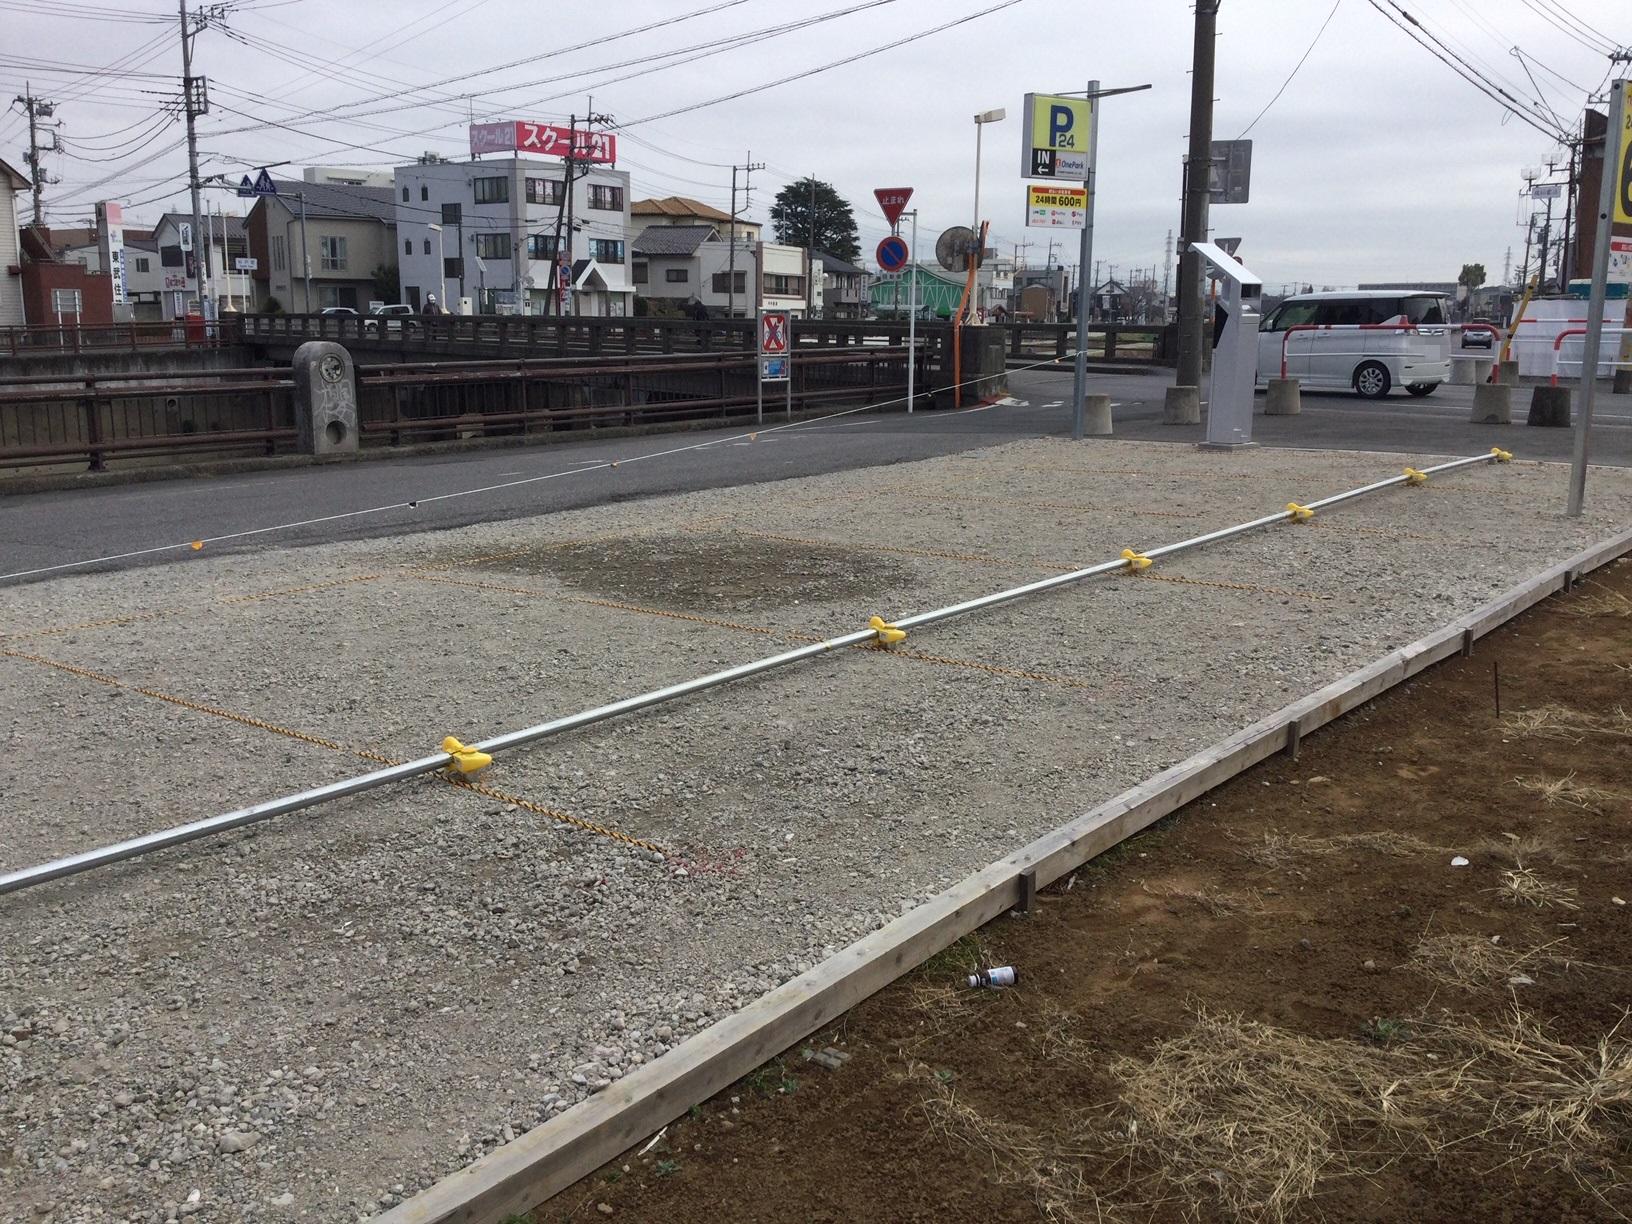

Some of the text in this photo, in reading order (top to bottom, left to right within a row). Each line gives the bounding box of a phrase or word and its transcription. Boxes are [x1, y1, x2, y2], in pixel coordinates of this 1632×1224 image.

[1049, 104, 1074, 147] P
[523, 124, 611, 160] スクール21
[1058, 134, 1075, 148] 24
[1037, 150, 1050, 164] IN
[882, 195, 905, 206] 止まれ
[1058, 196, 1082, 207] 600円
